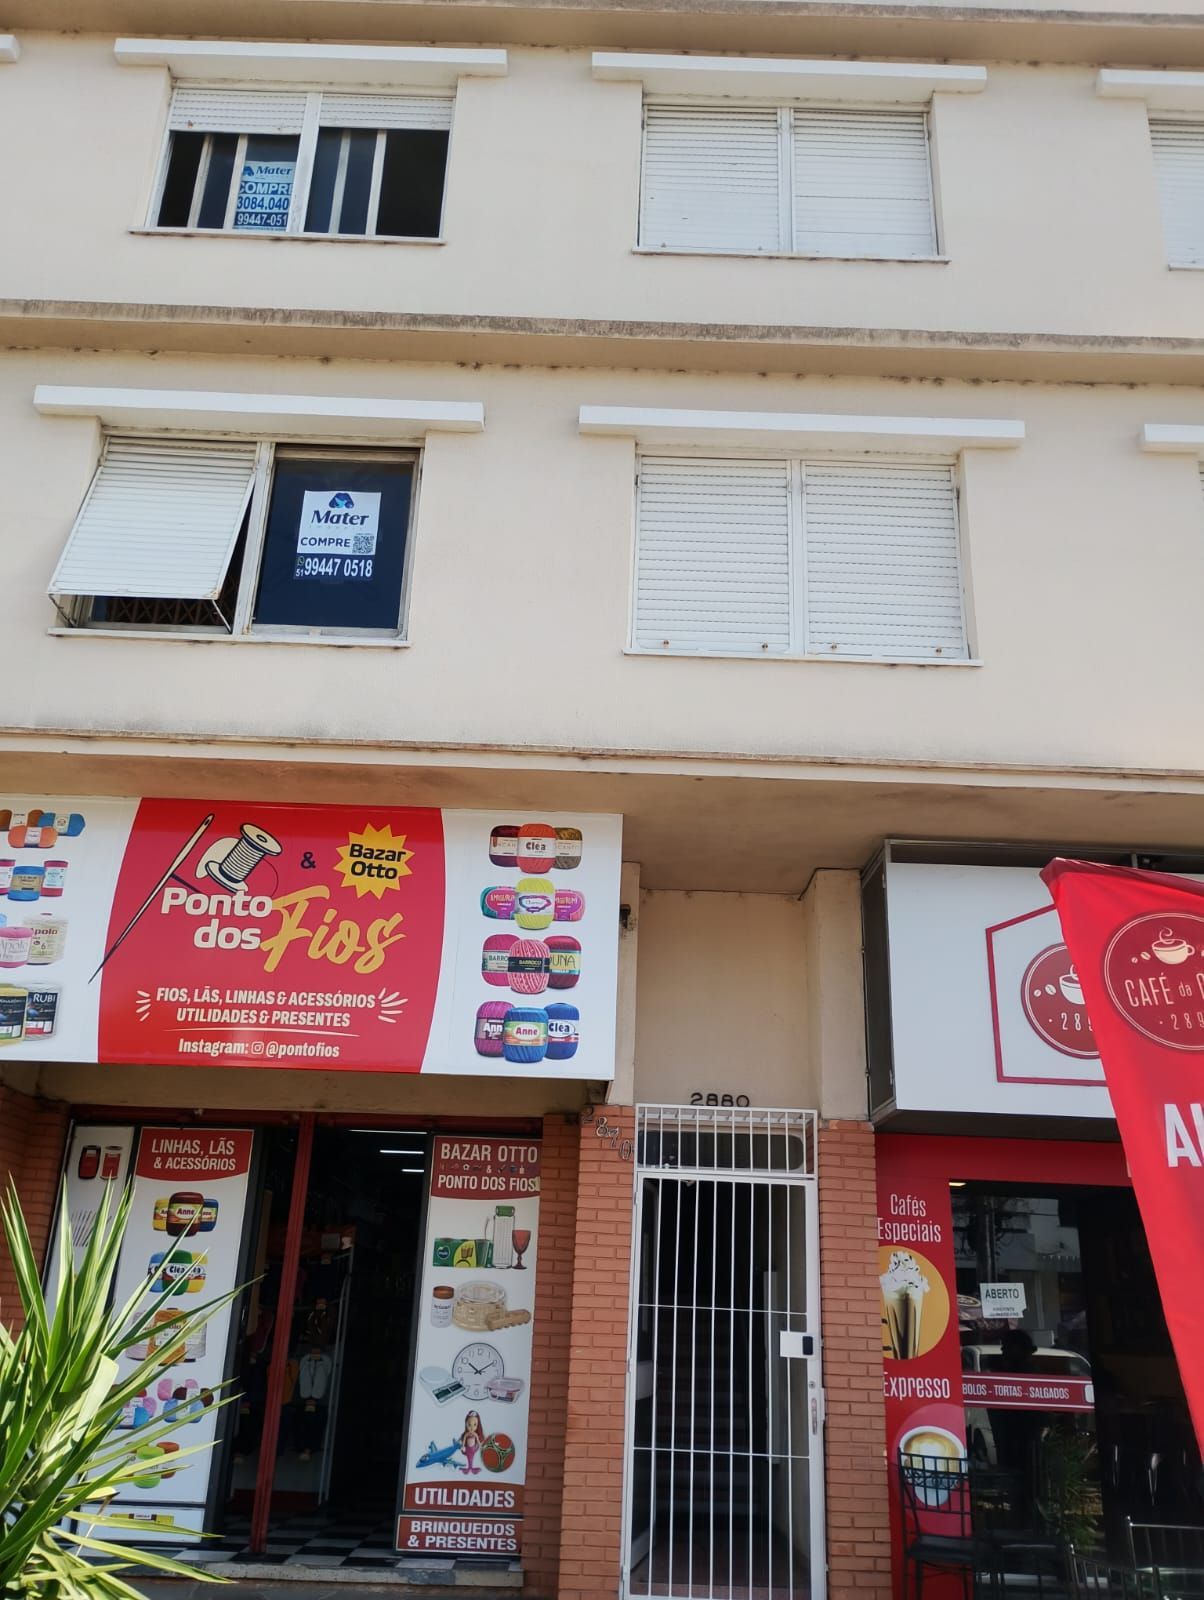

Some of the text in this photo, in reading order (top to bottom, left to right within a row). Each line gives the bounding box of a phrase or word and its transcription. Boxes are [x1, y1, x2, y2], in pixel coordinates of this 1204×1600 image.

[255, 166, 293, 175] Mater
[311, 510, 369, 525] Mater
[300, 537, 351, 547] COMPRE
[304, 557, 340, 576] 99447
[343, 559, 373, 577] 0518
[300, 851, 317, 869] &
[349, 843, 406, 863] Bazar
[350, 860, 398, 880] Otto
[161, 887, 273, 918] Ponto
[194, 918, 262, 950] dos
[260, 885, 407, 974] Fios
[33, 993, 56, 1003] RUBI
[156, 985, 375, 1008] FIOS, LÃS, LINHAS & ACESSÓRIOS
[1124, 972, 1175, 1008] CAFÉ
[1178, 981, 1193, 997] da
[176, 1007, 351, 1027] UTILIDADES & PRESENTES
[515, 1027, 538, 1035] Anne
[548, 1022, 570, 1032] Clea
[178, 1038, 340, 1058] Instagram: @pontofios
[690, 1092, 750, 1108] 2880
[151, 1137, 235, 1156] LINHAS, LÃS
[441, 1143, 538, 1163] BAZAR OTTO
[153, 1155, 236, 1171] & ACESSÓRIOS
[437, 1174, 535, 1192] PONTO DOS FIOS
[890, 1193, 927, 1217] Cafés
[877, 1217, 942, 1244] Especiais
[985, 1288, 1020, 1299] ABERTO
[962, 1383, 987, 1396] BOLOS
[994, 1384, 1023, 1397] TORTAS
[1029, 1385, 1069, 1400] SALGADOS
[414, 1487, 515, 1508] UTILIDADES
[410, 1520, 515, 1536] BRINQUEDOS
[407, 1535, 517, 1551] & PRESENTES
